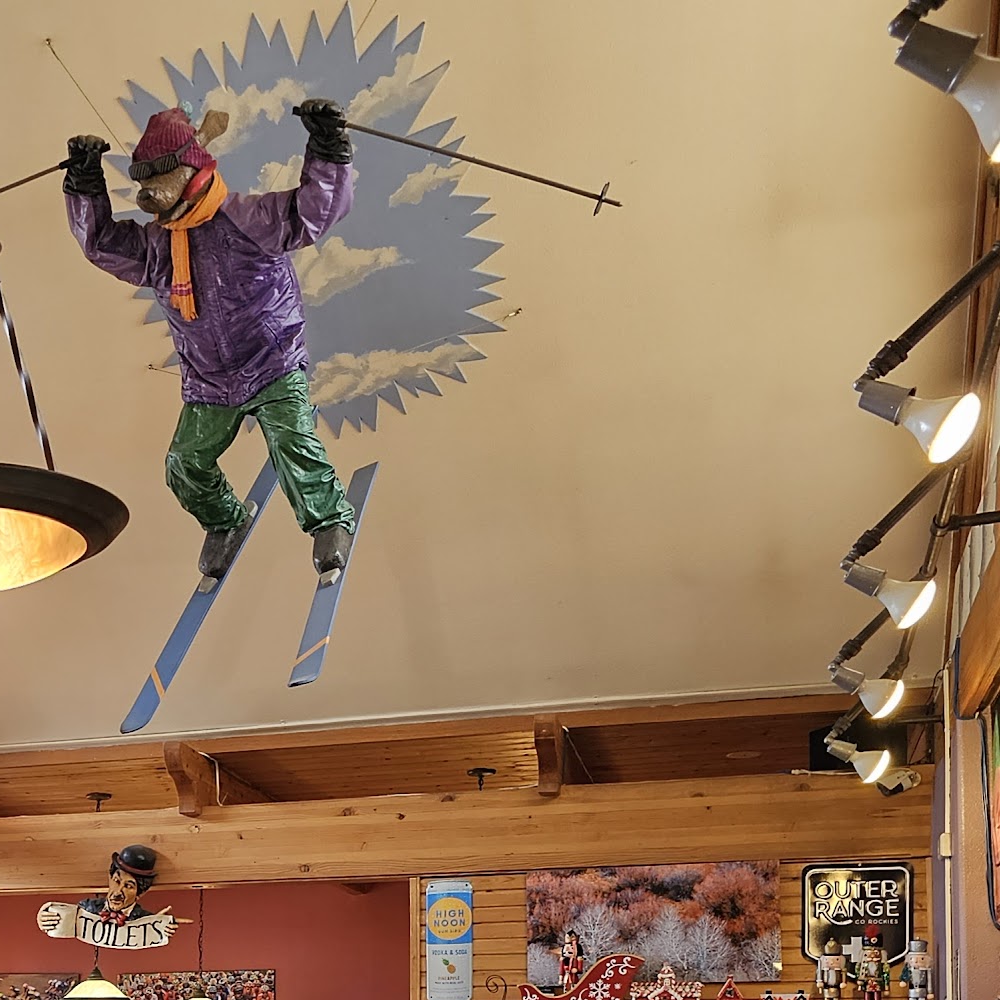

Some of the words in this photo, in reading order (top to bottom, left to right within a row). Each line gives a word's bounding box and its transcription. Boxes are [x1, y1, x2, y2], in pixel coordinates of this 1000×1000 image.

[814, 880, 899, 900] OUTER
[435, 909, 465, 918] HIGH
[814, 899, 900, 925] RANGE
[79, 915, 164, 947] TOILETS
[433, 918, 466, 927] NOON
